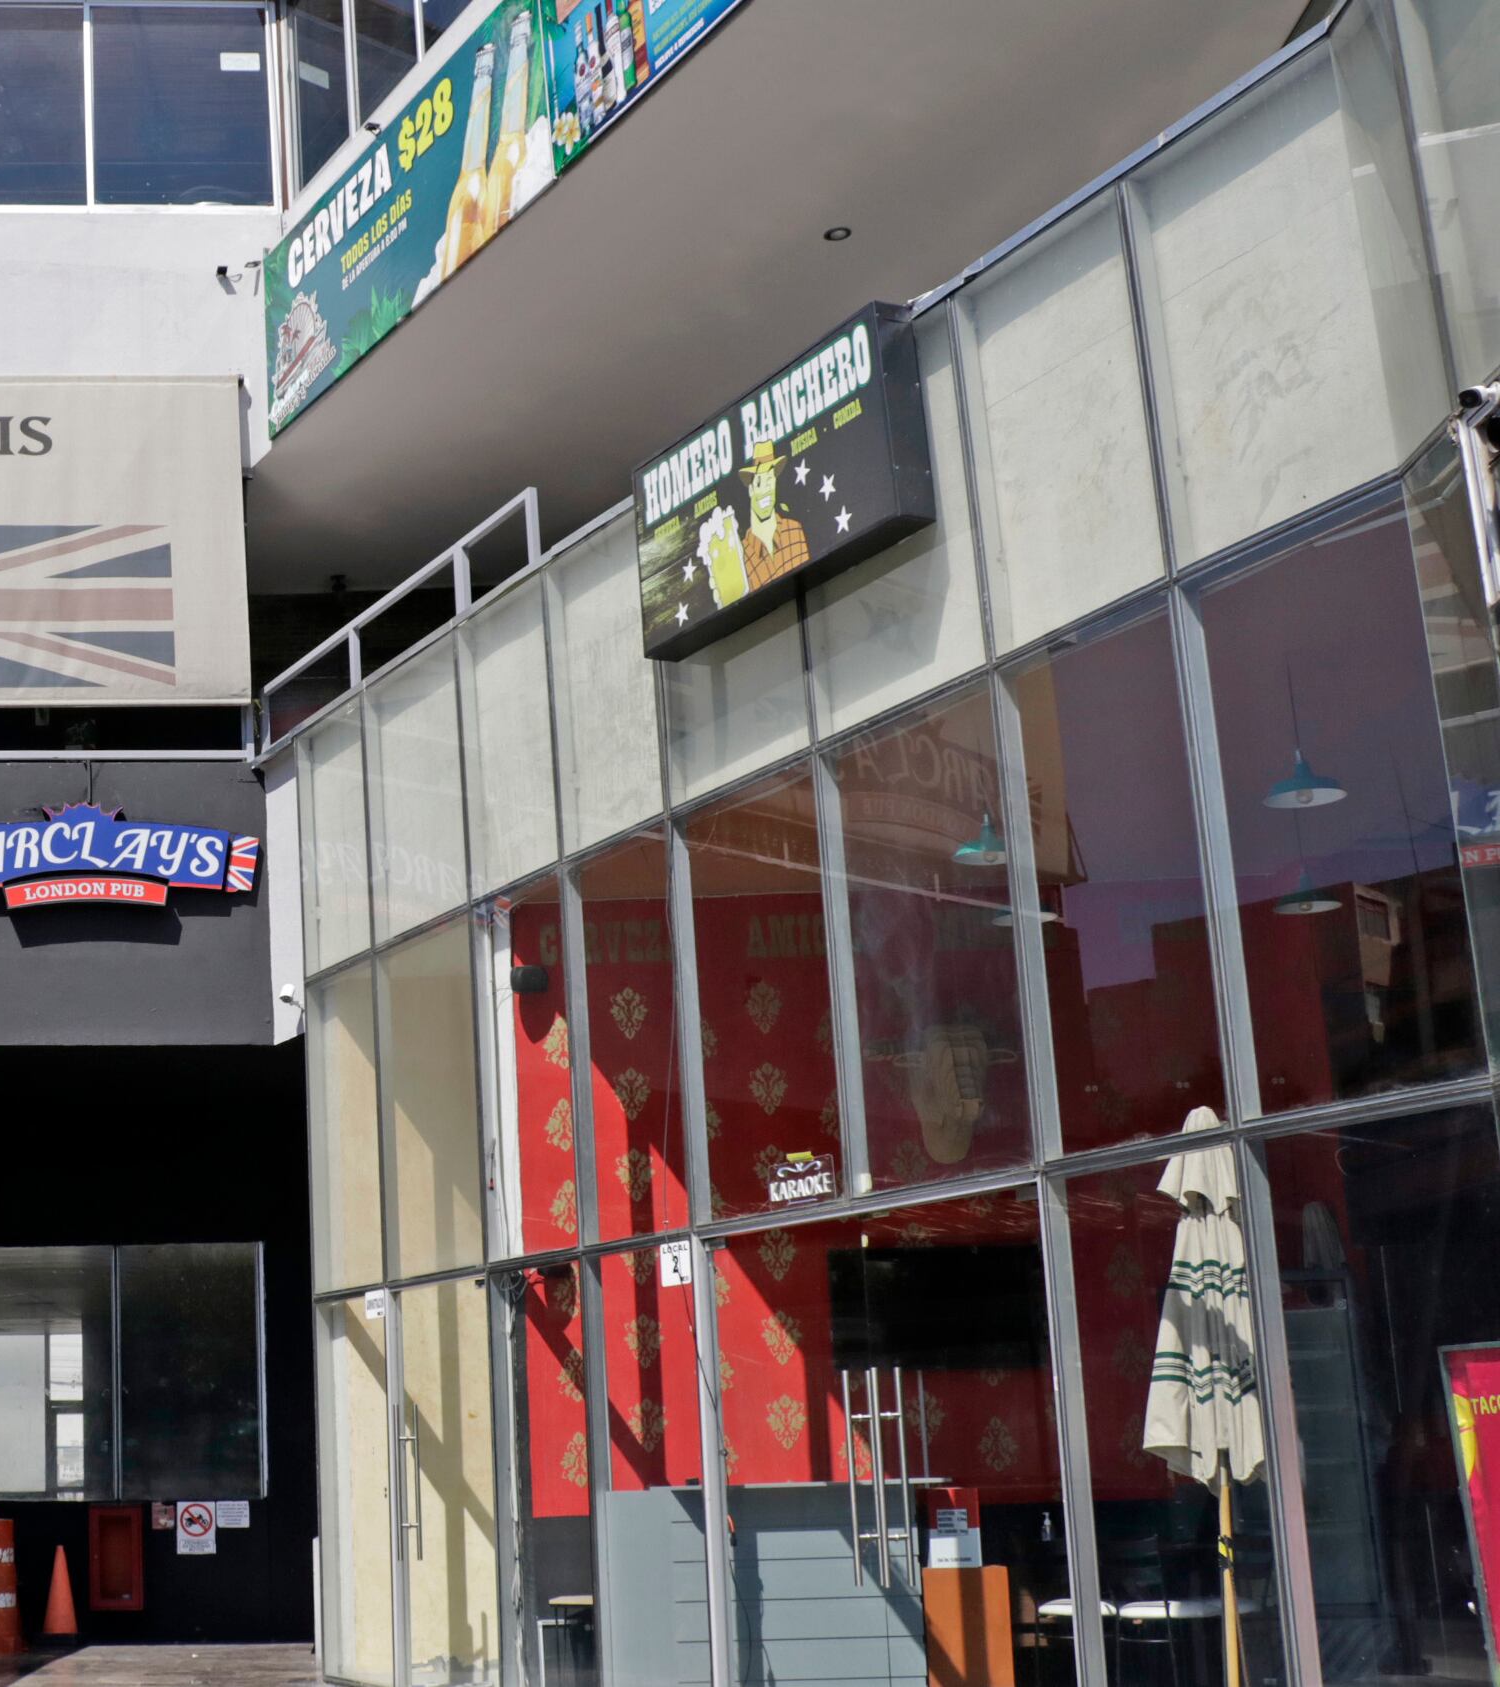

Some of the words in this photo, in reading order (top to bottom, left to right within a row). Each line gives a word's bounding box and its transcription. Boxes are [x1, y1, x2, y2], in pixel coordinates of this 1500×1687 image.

[287, 142, 392, 289] CERVEZA
[397, 77, 454, 173] $28
[340, 232, 370, 273] TODOS
[371, 212, 388, 244] LOS
[389, 188, 412, 225] DÍAS
[341, 275, 349, 291] DE
[349, 269, 356, 284] LA
[355, 243, 381, 277] APERTURA
[643, 418, 732, 525] HOMERO
[741, 323, 871, 460] RANCHERO
[24, 882, 102, 901] LONDON
[109, 882, 146, 899] PUB
[769, 1172, 832, 1202] KARAOKE
[662, 1243, 688, 1254] LOCAL
[672, 1256, 679, 1273] 2
